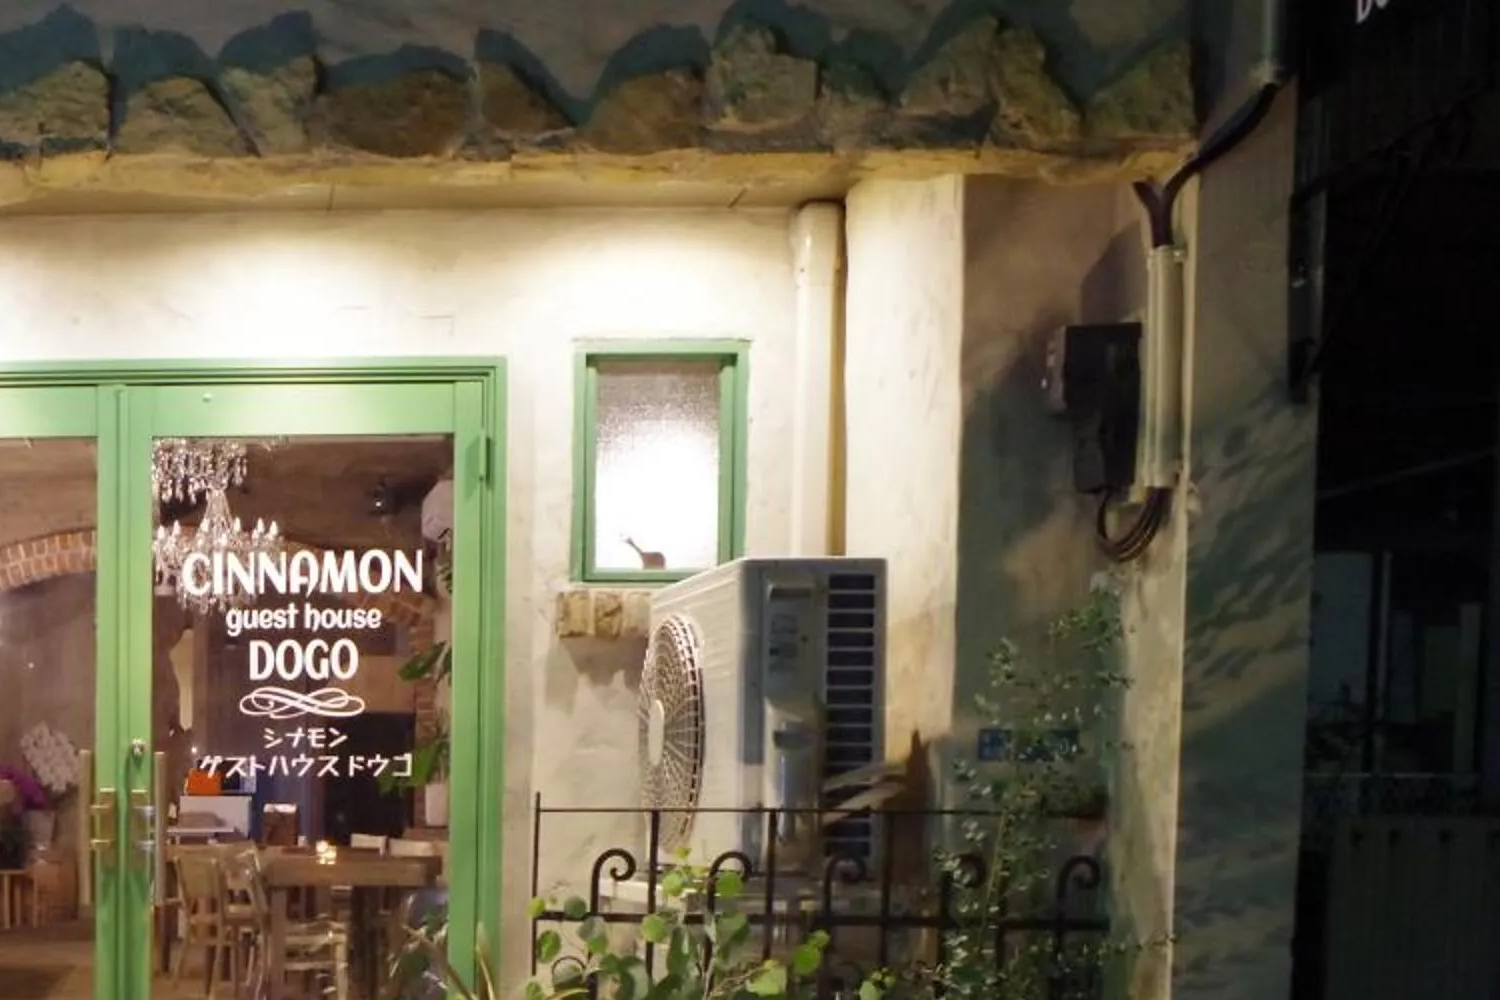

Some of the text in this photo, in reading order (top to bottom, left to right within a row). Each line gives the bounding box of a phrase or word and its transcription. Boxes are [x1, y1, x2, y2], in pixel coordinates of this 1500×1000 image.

[181, 549, 423, 597] CINNAMON
[225, 602, 382, 637] guest house
[249, 638, 359, 681] DOGO
[263, 727, 348, 748] シナモン
[200, 753, 412, 778] ゲストハウス ドウゴ
